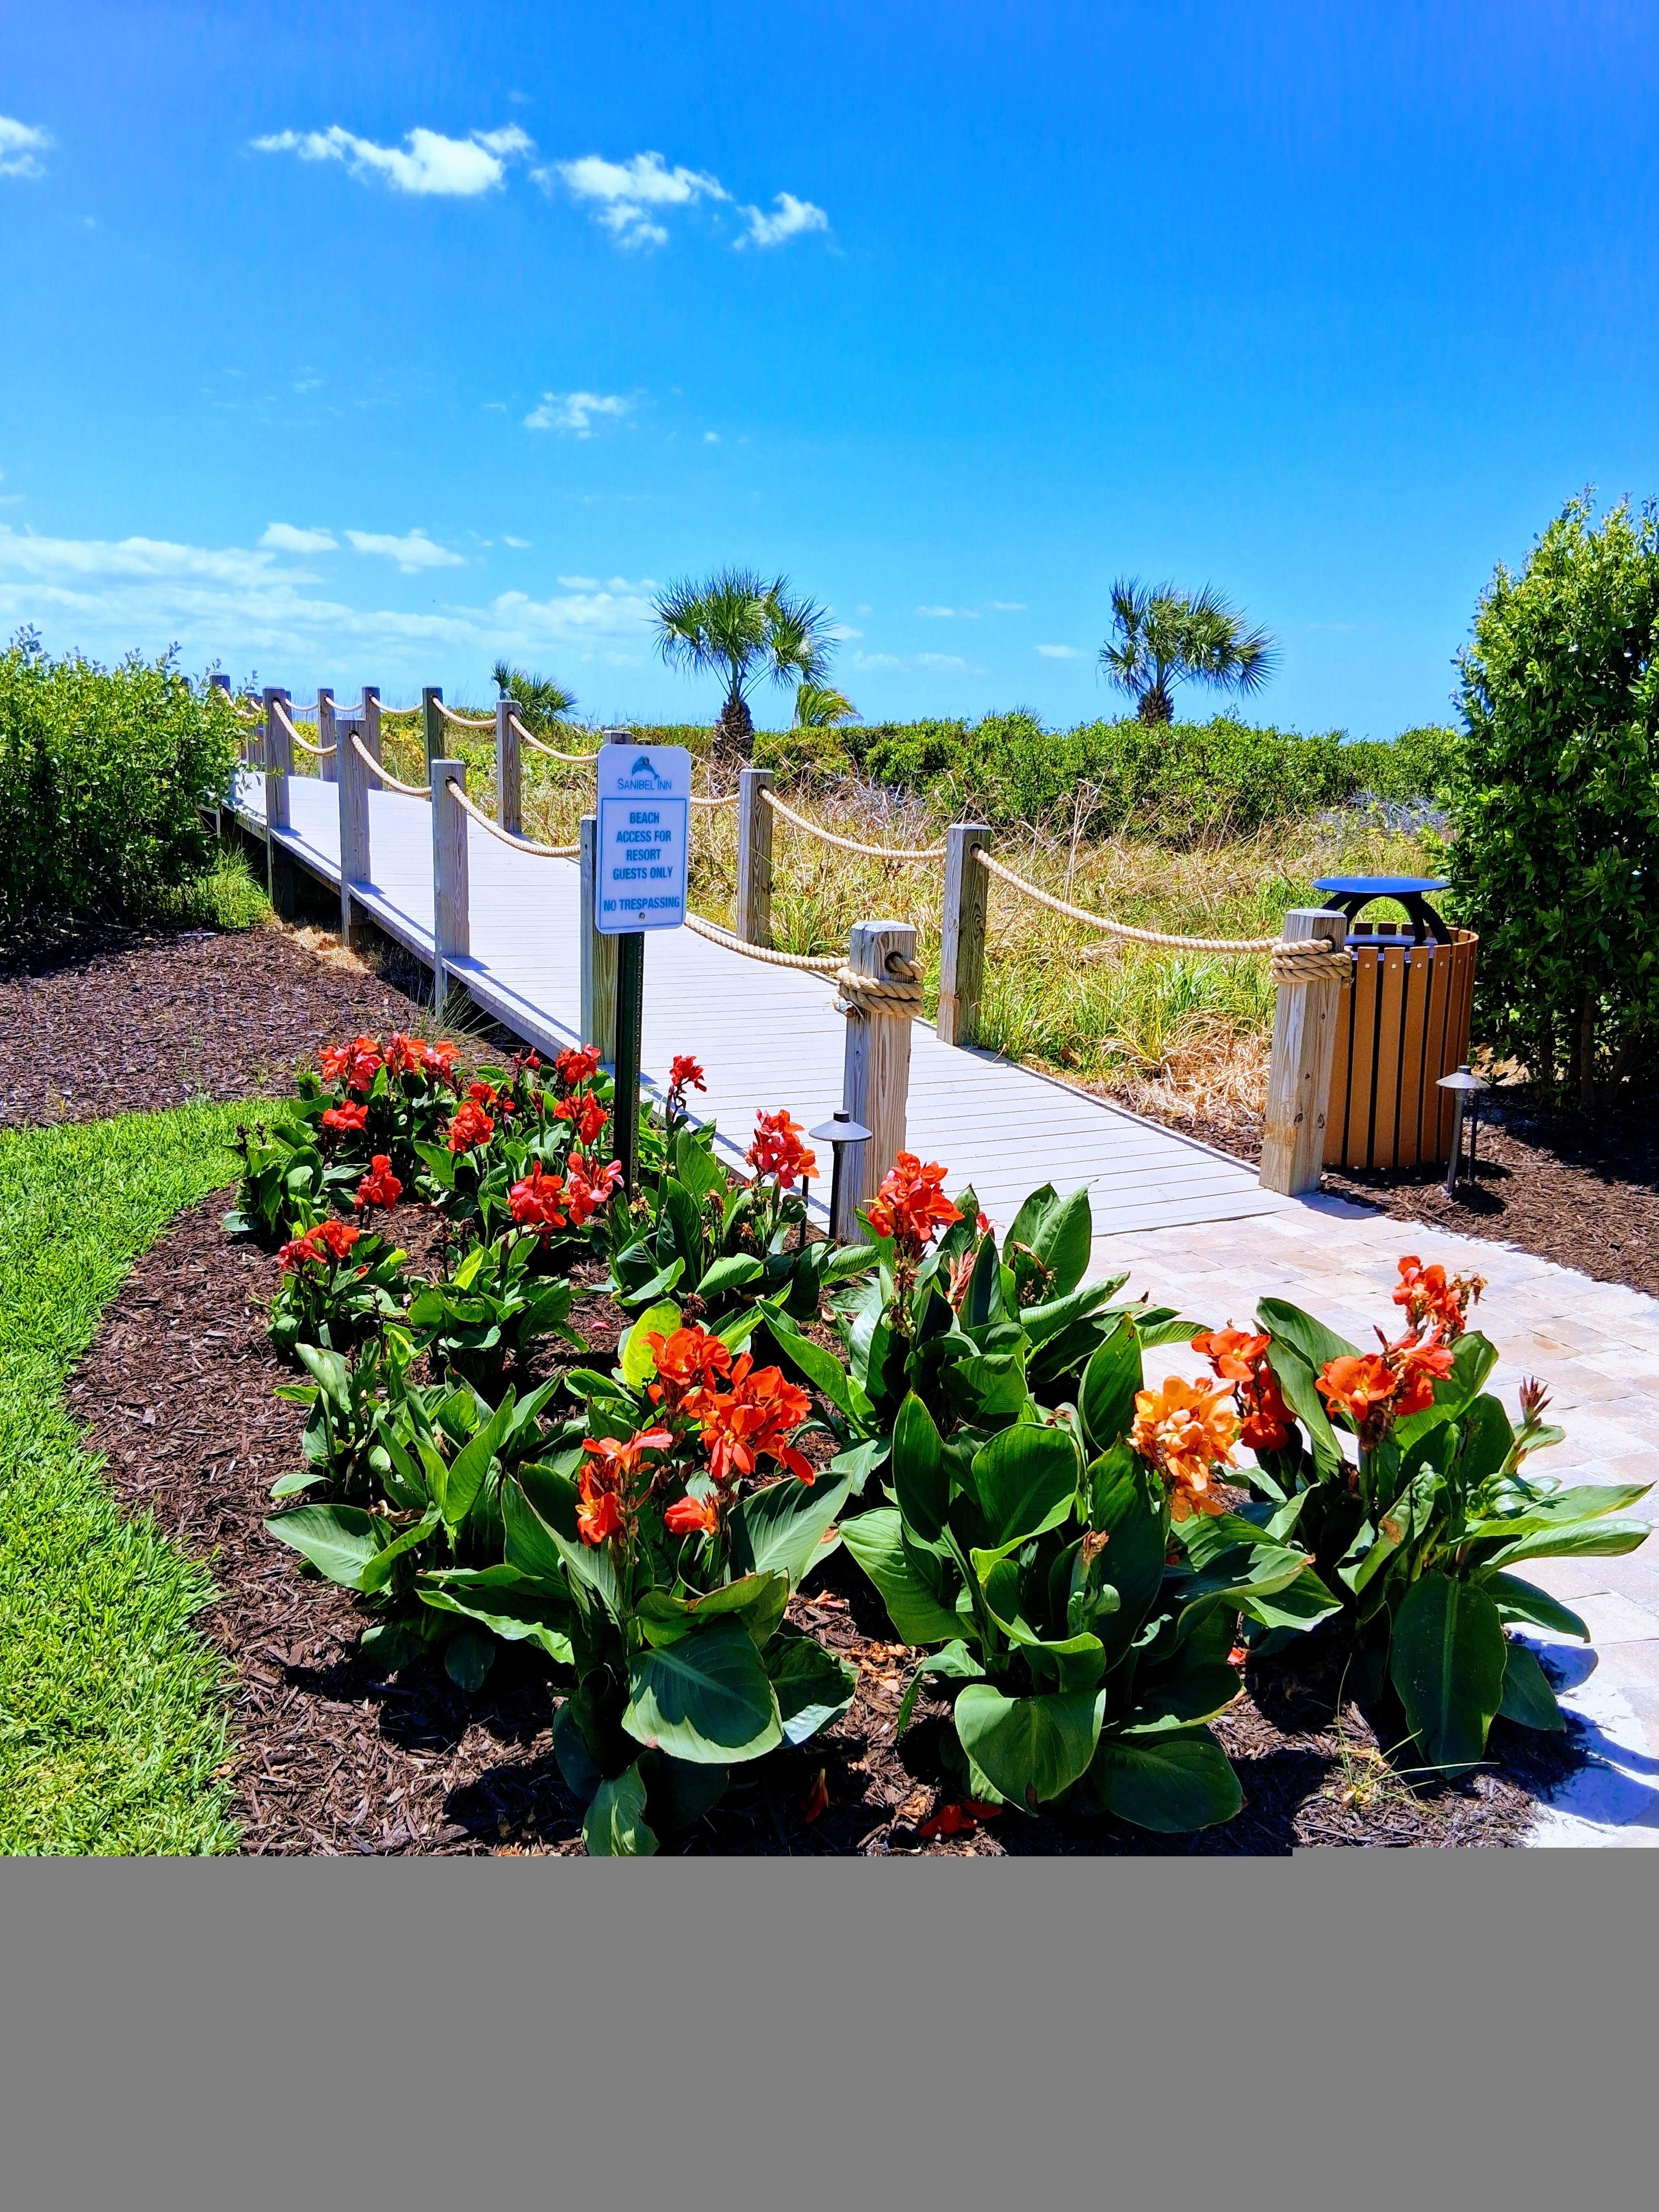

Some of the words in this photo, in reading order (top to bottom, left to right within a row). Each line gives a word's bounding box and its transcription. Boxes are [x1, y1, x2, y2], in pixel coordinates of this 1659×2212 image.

[618, 779, 654, 790] SANIBEL
[657, 779, 671, 790] INN
[629, 812, 659, 824] BEACH
[616, 831, 651, 843] ACCESS
[654, 831, 671, 841] FOR
[626, 849, 661, 861] RESORT
[613, 867, 647, 880] GUESTS
[650, 867, 673, 879] ONLY
[604, 899, 616, 911] NO
[619, 897, 679, 911] TRESPASSING
